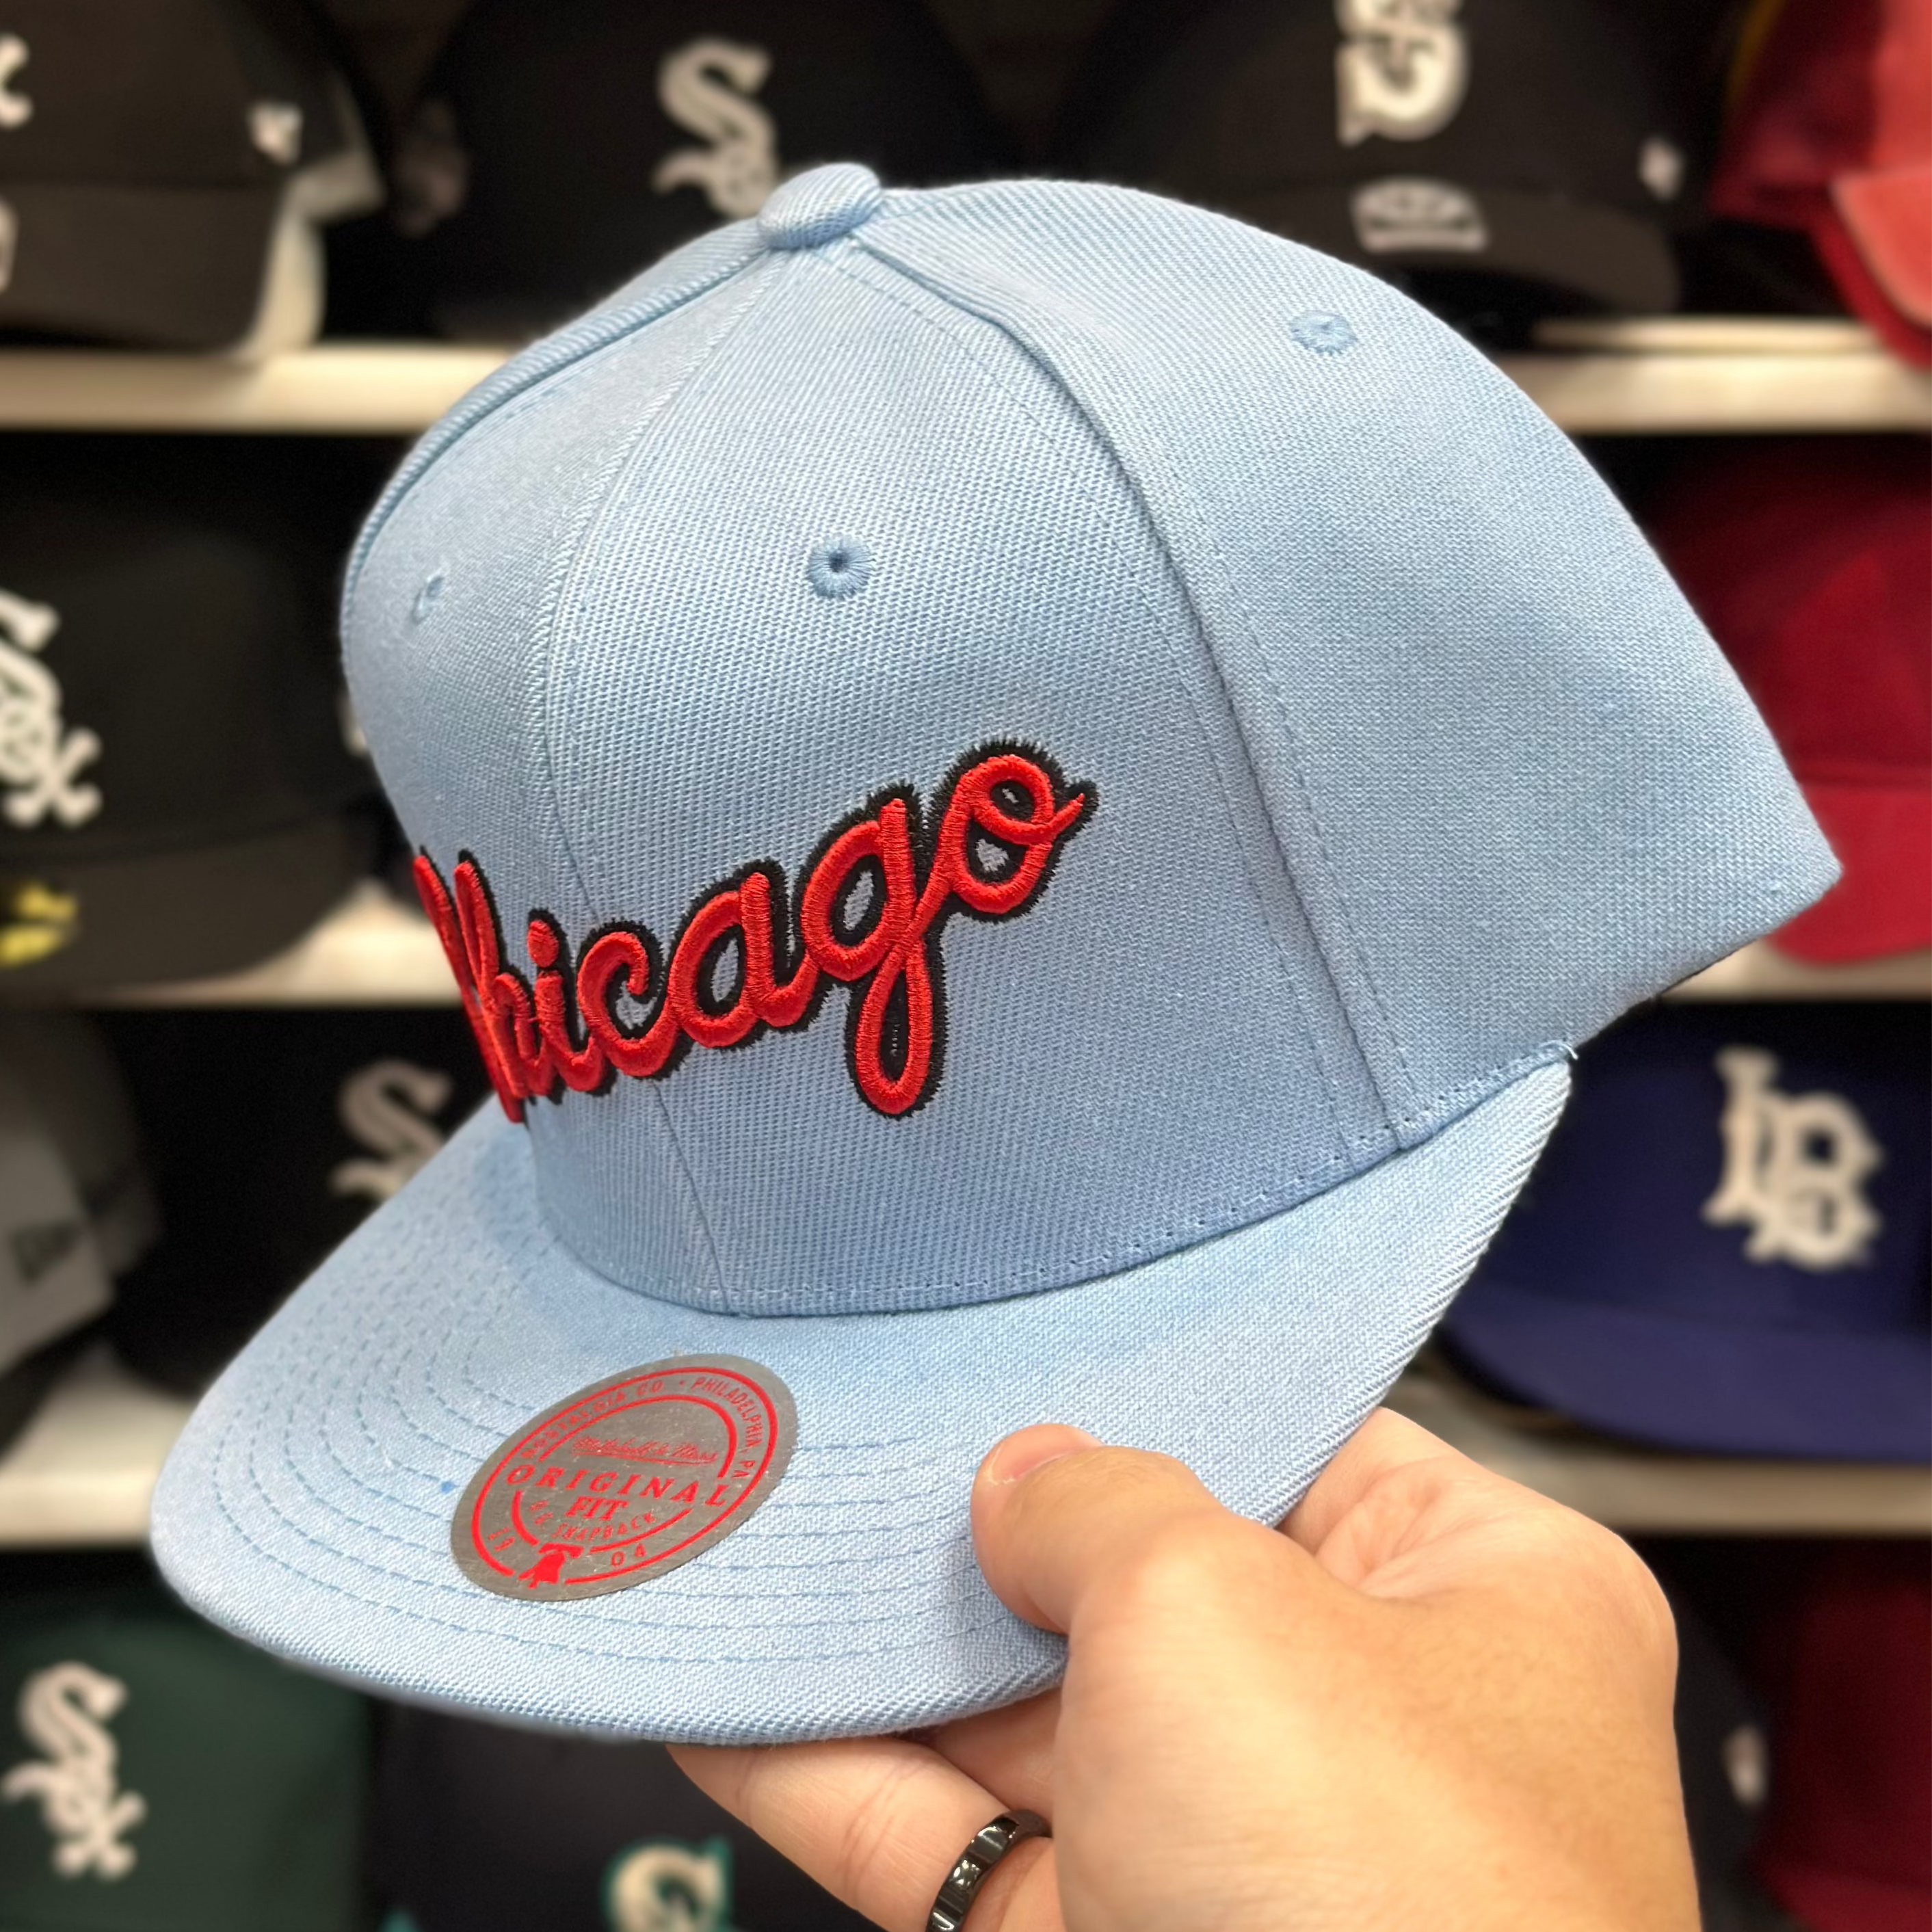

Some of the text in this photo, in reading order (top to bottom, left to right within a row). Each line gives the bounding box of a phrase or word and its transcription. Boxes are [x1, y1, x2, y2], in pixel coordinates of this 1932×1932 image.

[637, 1379, 664, 1397] CO
[732, 1460, 756, 1479] PA
[506, 1466, 730, 1507] ORIGINAL
[551, 1510, 657, 1542] SNAPBACK
[565, 1496, 628, 1521] FIT
